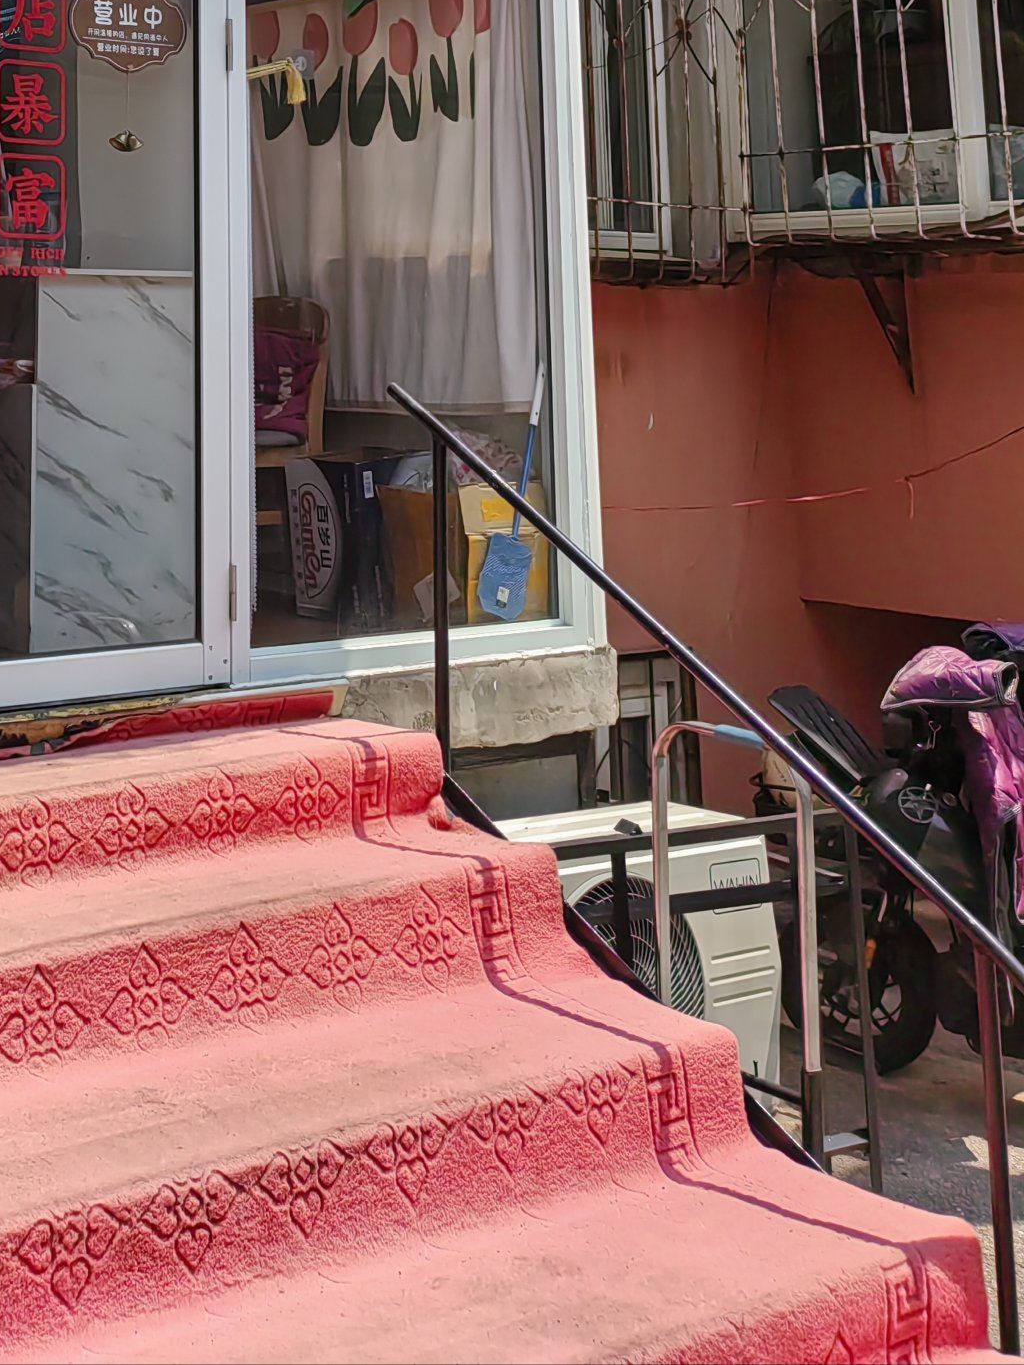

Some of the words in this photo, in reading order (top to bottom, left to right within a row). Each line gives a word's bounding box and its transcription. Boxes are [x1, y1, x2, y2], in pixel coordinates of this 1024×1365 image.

[93, 0, 163, 30] 营业中
[316, 504, 332, 569] 百岁山
